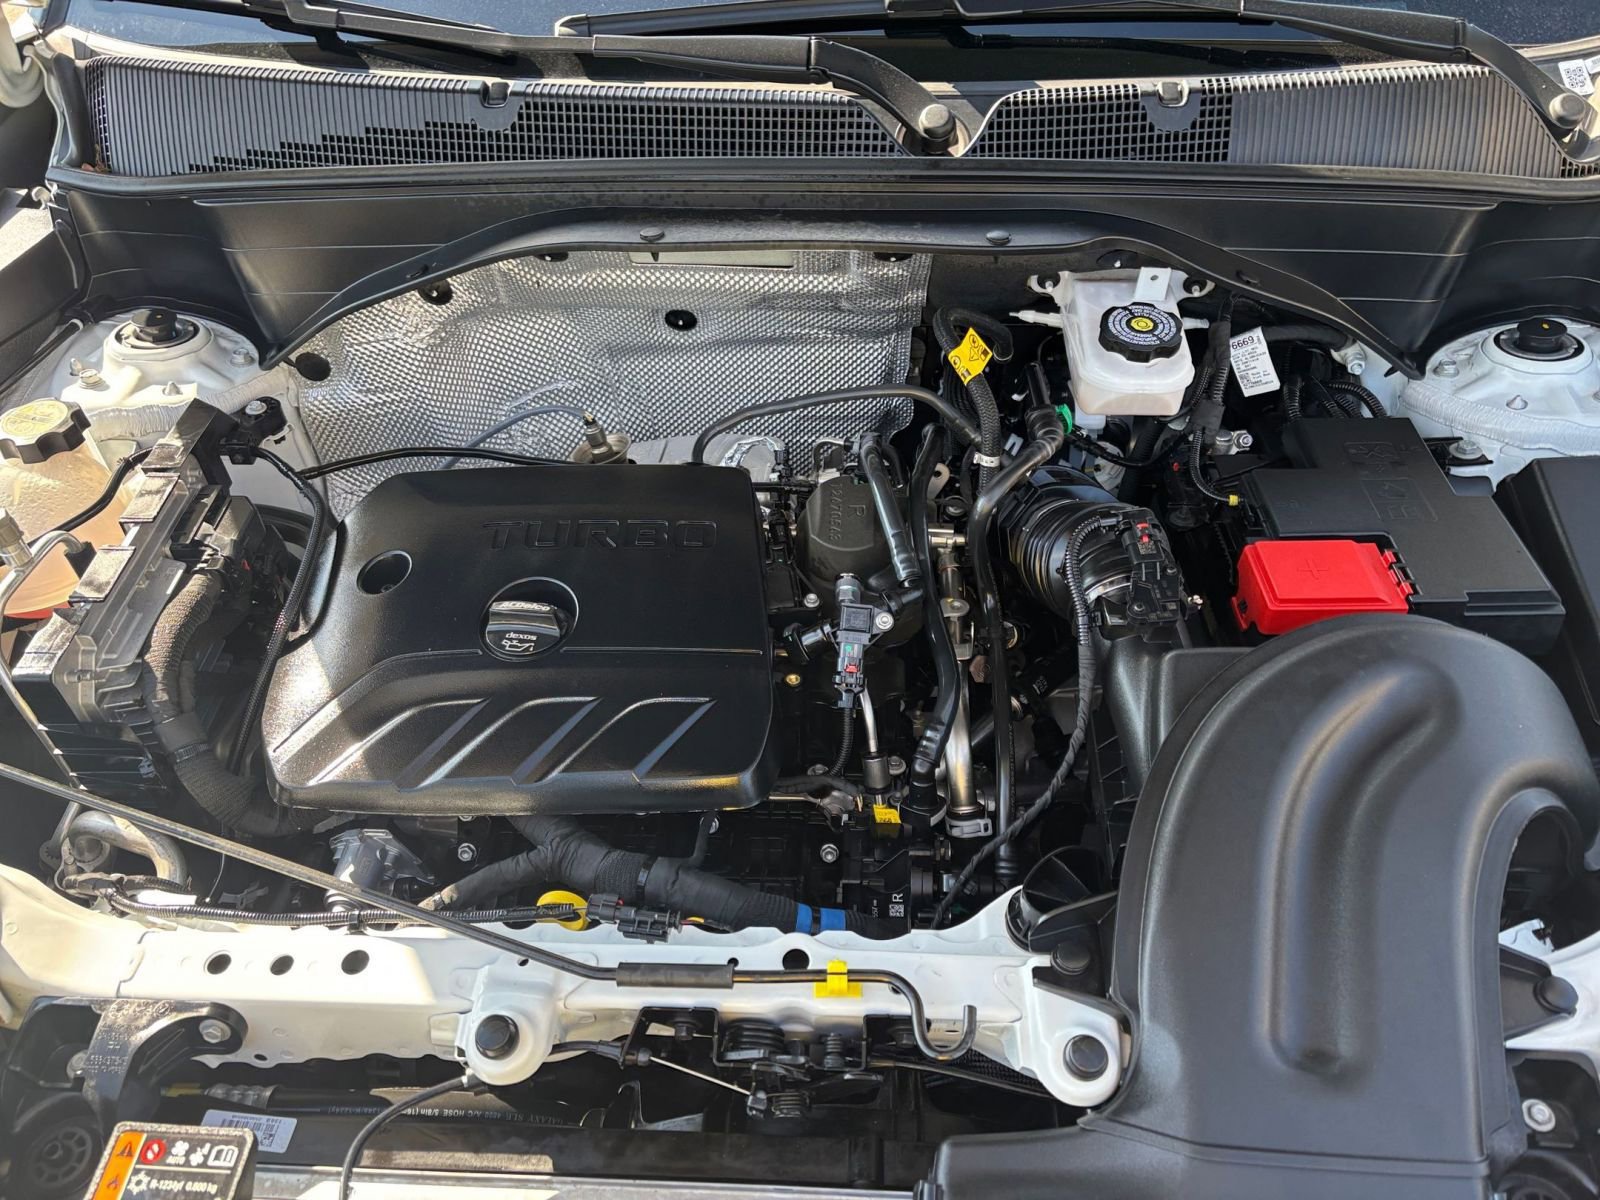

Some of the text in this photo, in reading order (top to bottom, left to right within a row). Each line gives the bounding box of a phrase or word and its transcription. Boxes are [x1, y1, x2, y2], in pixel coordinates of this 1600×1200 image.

[1231, 335, 1255, 350] 6669
[848, 504, 866, 518] R
[482, 519, 718, 550] TURBO
[499, 601, 551, 611] ACDelco
[505, 631, 538, 641] dexos
[892, 893, 904, 902] R
[442, 1109, 465, 1118] HOSE
[467, 1109, 482, 1118] A/C
[166, 1156, 186, 1165] AUTO
